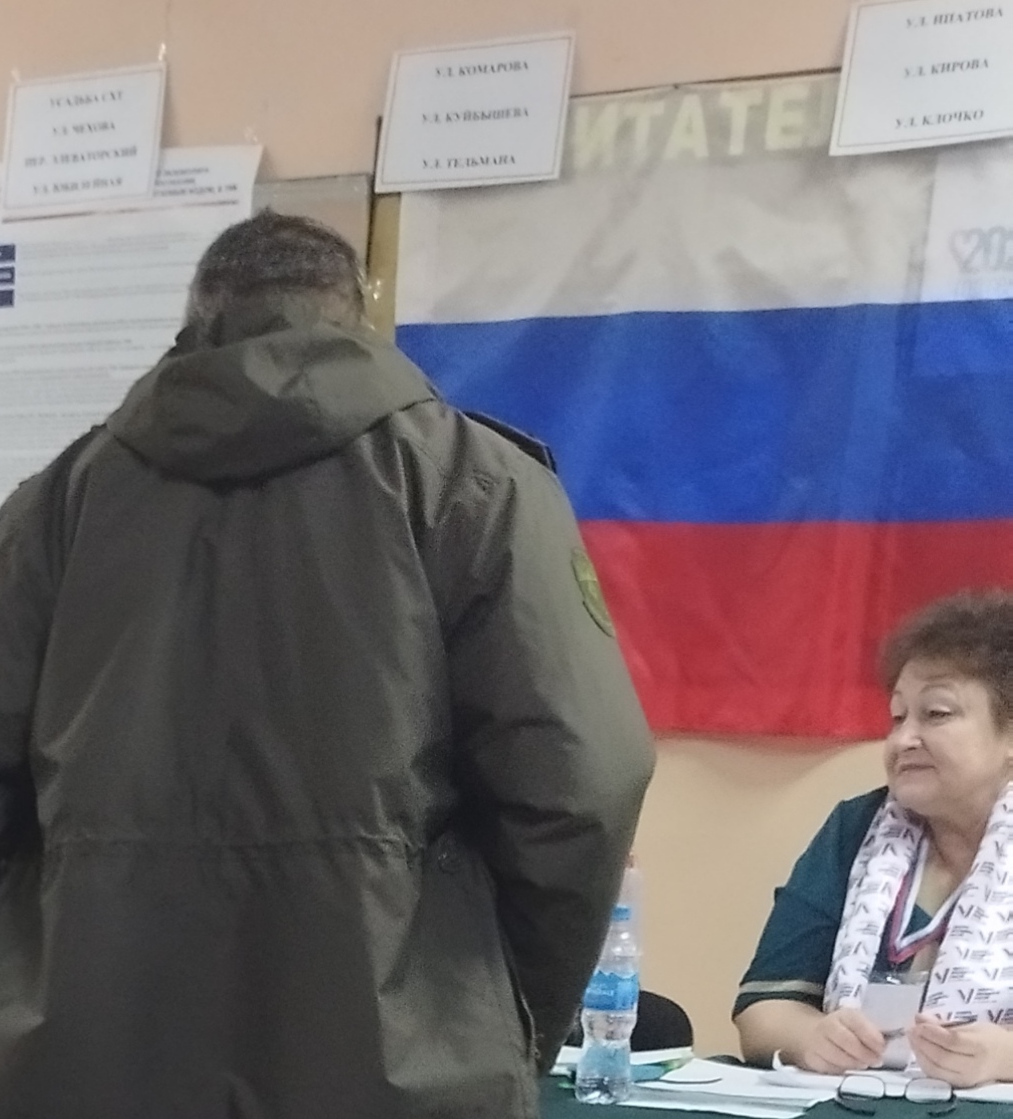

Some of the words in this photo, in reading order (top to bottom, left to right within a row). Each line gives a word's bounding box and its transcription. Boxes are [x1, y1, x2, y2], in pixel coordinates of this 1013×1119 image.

[933, 8, 1004, 26] ИПАТОВА
[458, 60, 530, 77] КОМАРОВА
[931, 58, 989, 76] КИРОВА
[445, 107, 529, 123] КУЙБЫШЕВА
[921, 109, 985, 127] КЛОЧКО
[573, 82, 838, 169] ИТАТЕ
[446, 154, 516, 169] ТЕЛЬМАНА
